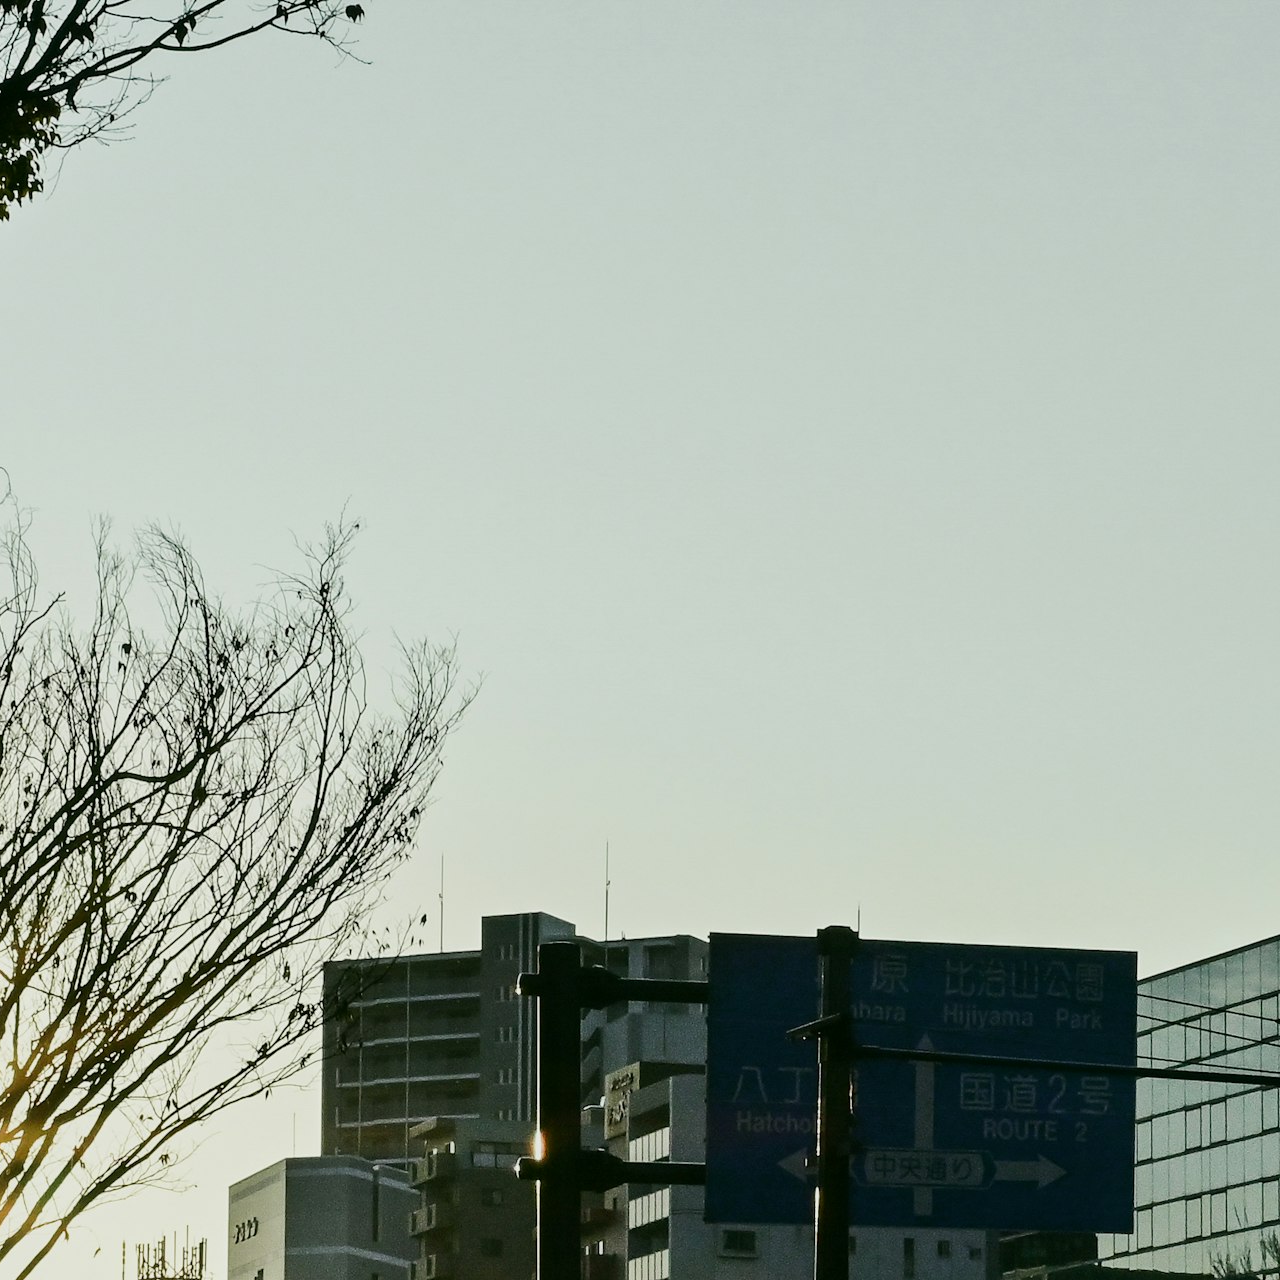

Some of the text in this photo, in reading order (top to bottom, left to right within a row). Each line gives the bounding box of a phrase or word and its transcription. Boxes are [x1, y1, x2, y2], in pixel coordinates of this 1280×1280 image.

[944, 957, 1104, 1002] 比治山公園
[943, 1005, 1035, 1030] Hijiyama
[1056, 1008, 1103, 1031] Park
[731, 1064, 857, 1104] 八丁
[959, 1072, 1114, 1116] 国道2号
[736, 1110, 818, 1134] Hatcho
[983, 1118, 1089, 1142] ROUTE 2
[874, 1154, 973, 1182] 中央通り
